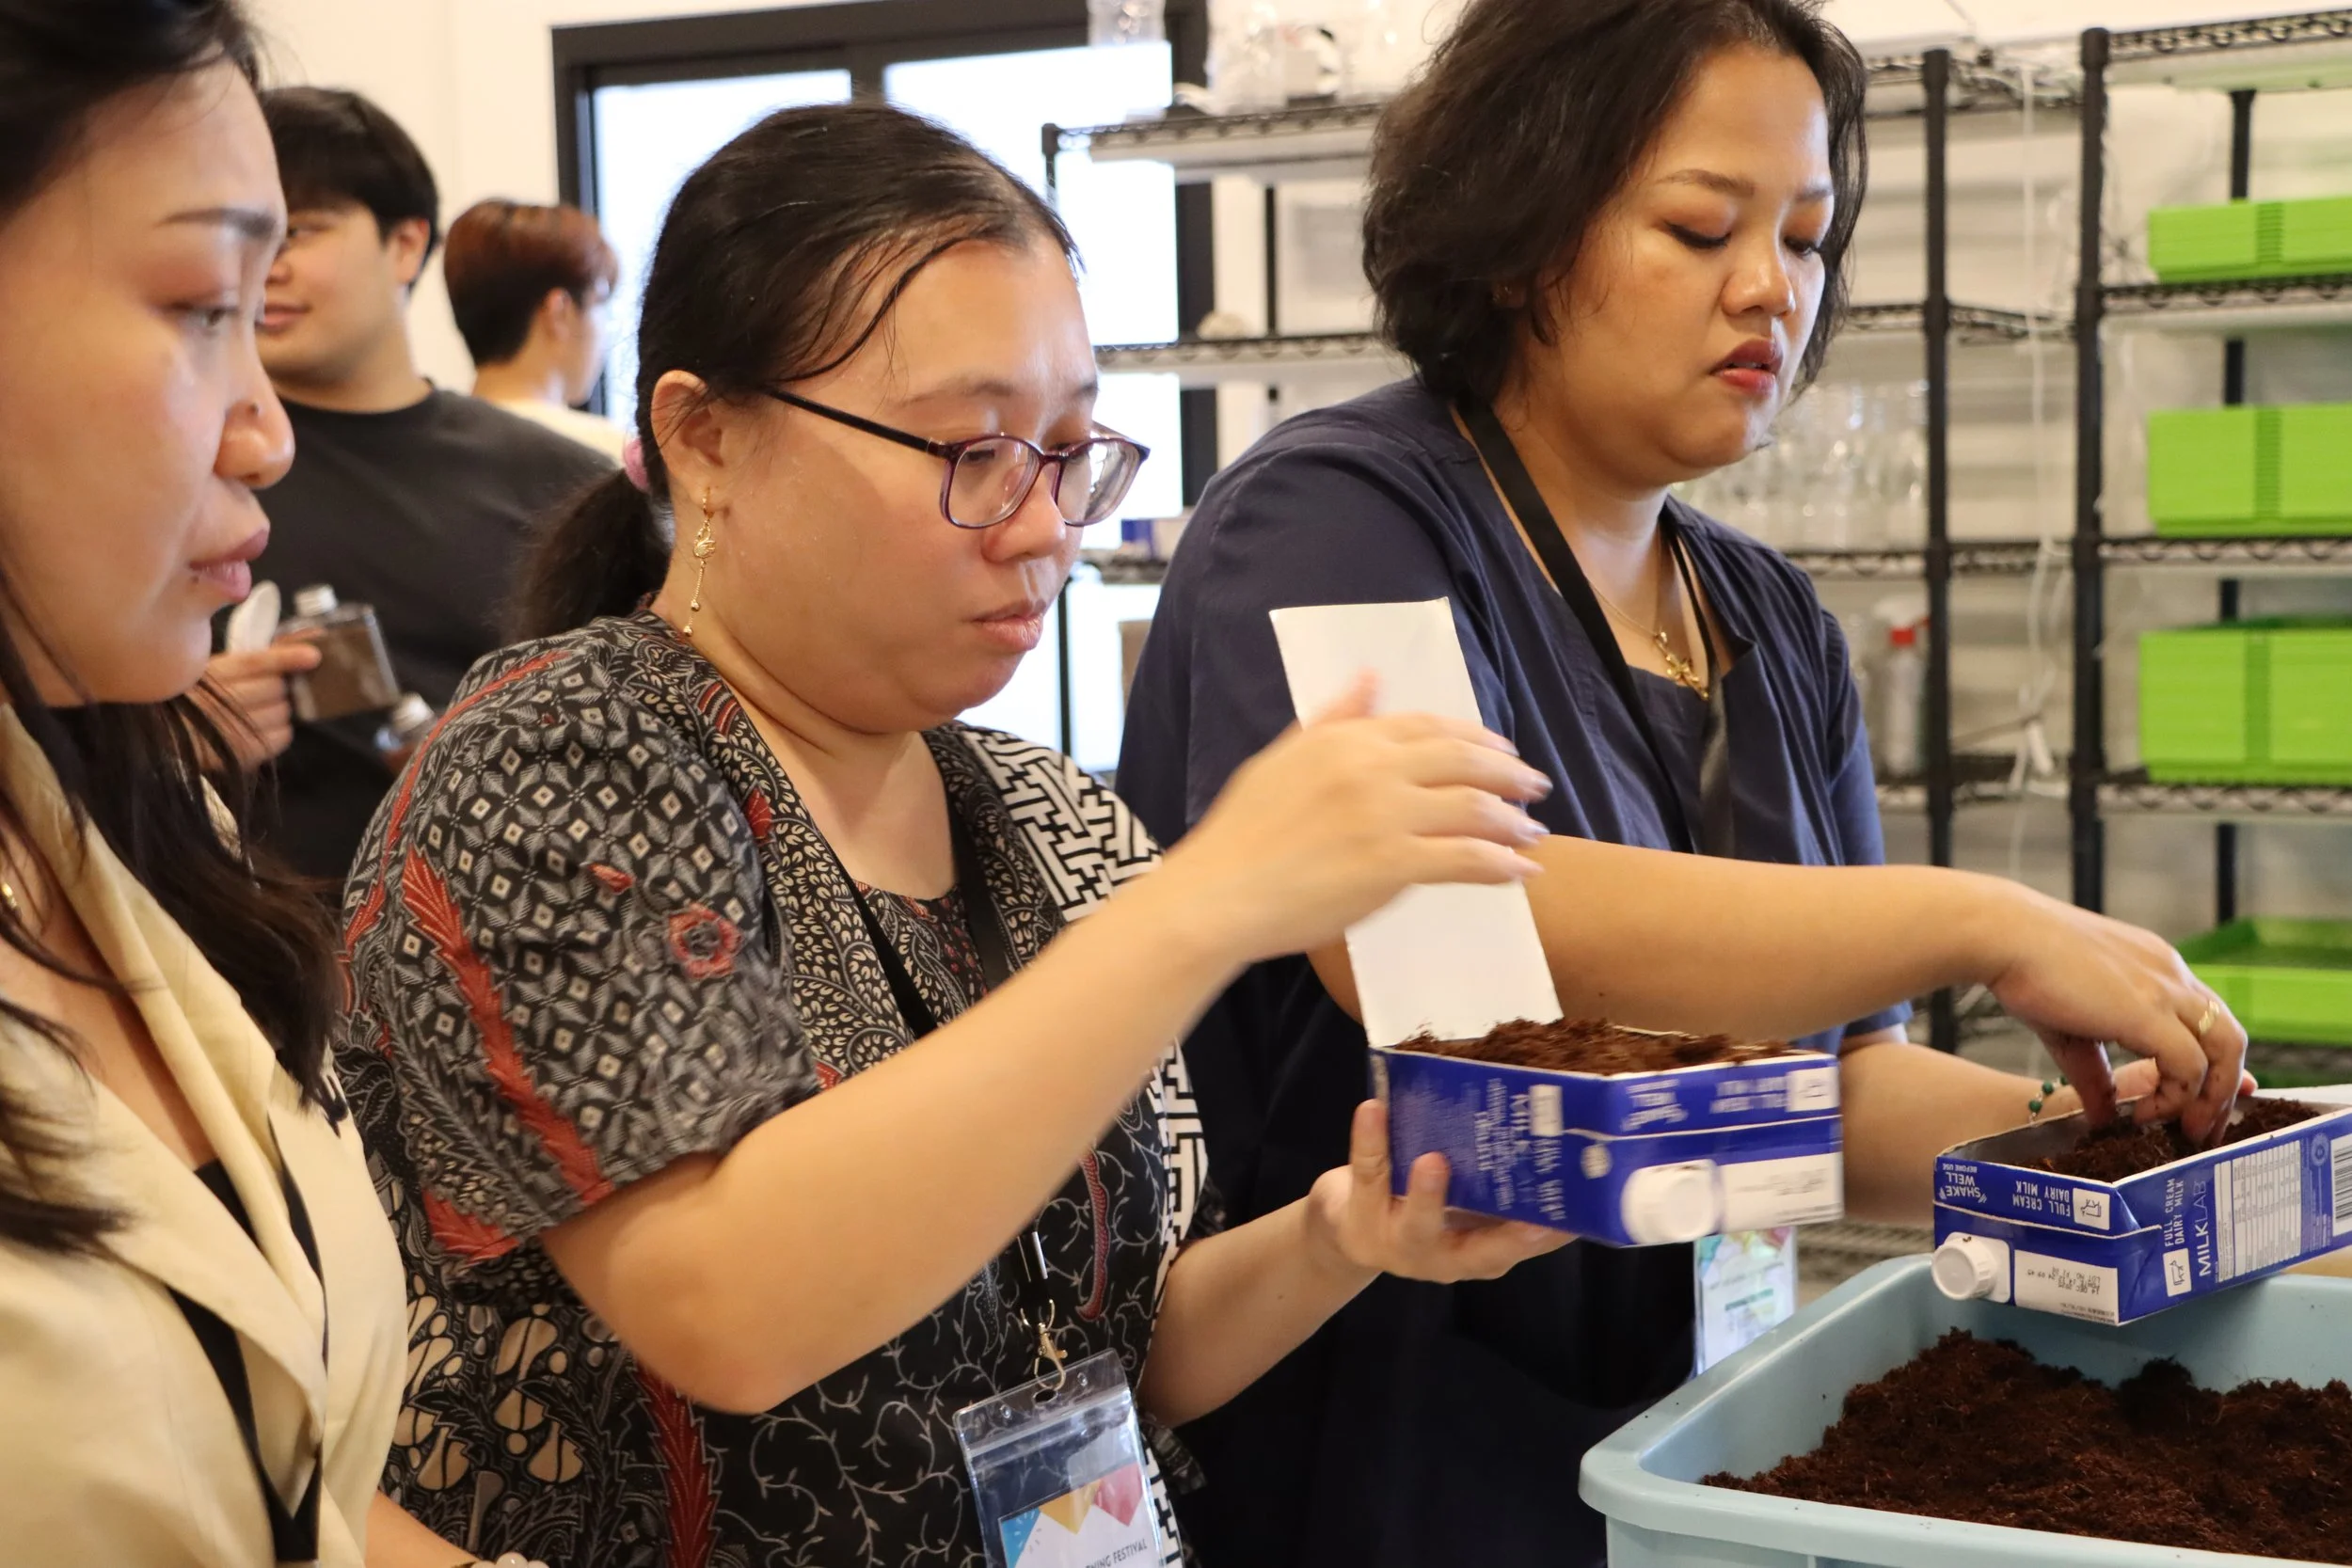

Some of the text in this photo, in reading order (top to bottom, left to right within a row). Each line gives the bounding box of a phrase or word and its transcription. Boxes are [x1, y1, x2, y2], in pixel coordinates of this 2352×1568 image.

[1942, 1163, 1978, 1173] BEFORE USE
[1945, 1171, 1975, 1186] WELL
[1945, 1185, 1980, 1197] SHAKE
[2015, 1180, 2070, 1203] DAIRY MILK
[2012, 1194, 2071, 1217] FULL CREAM
[2164, 1178, 2175, 1247] FULL CREAM
[2173, 1180, 2185, 1245] DAIRY MILK
[2193, 1180, 2211, 1276] MILKLAB
[1112, 1538, 1148, 1564] FESTIVAL
